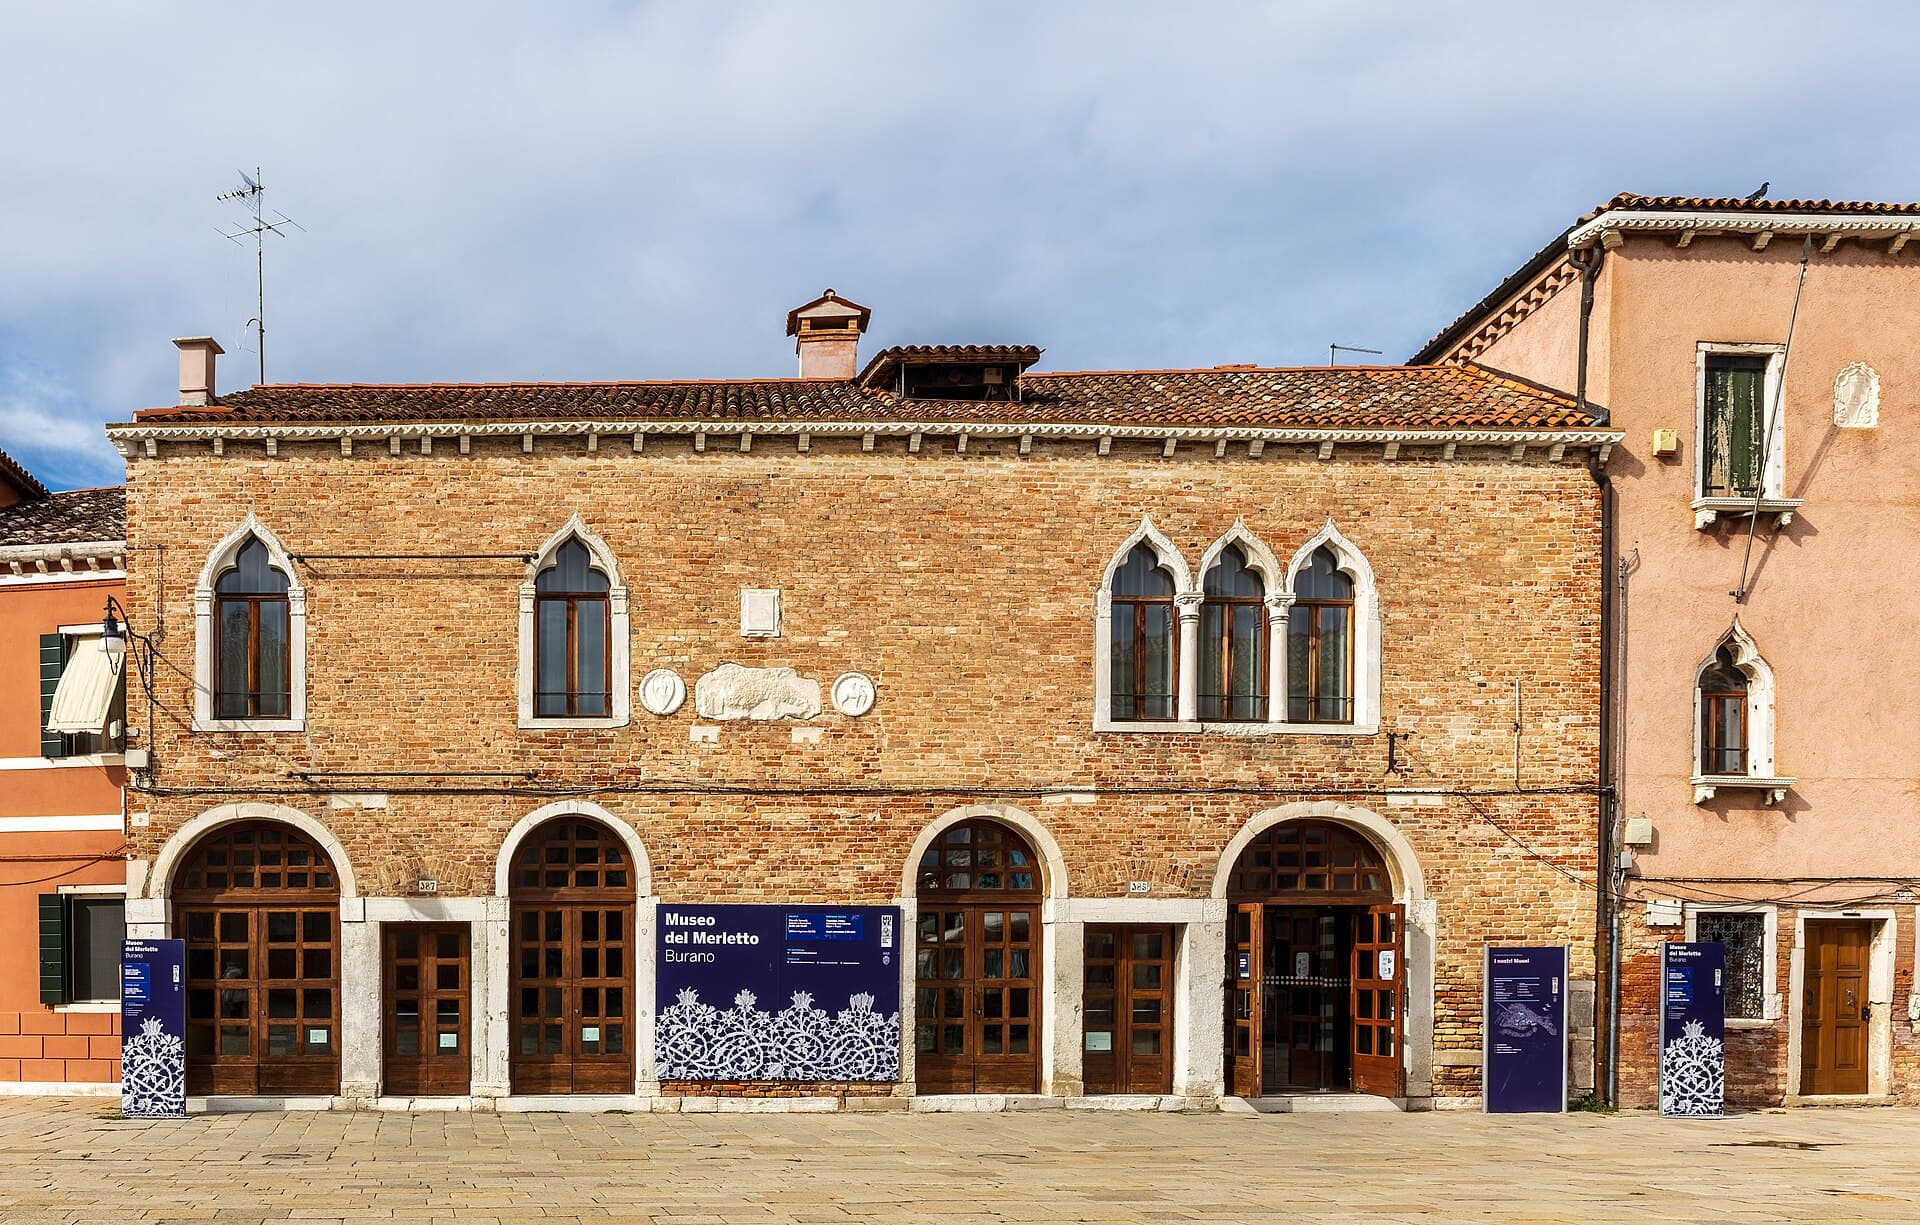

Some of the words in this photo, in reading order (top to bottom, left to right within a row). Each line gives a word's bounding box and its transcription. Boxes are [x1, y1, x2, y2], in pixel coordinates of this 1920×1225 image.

[665, 912, 716, 926] Museo
[664, 931, 688, 944] del
[693, 931, 760, 945] Merletto
[665, 949, 715, 963] Burano
